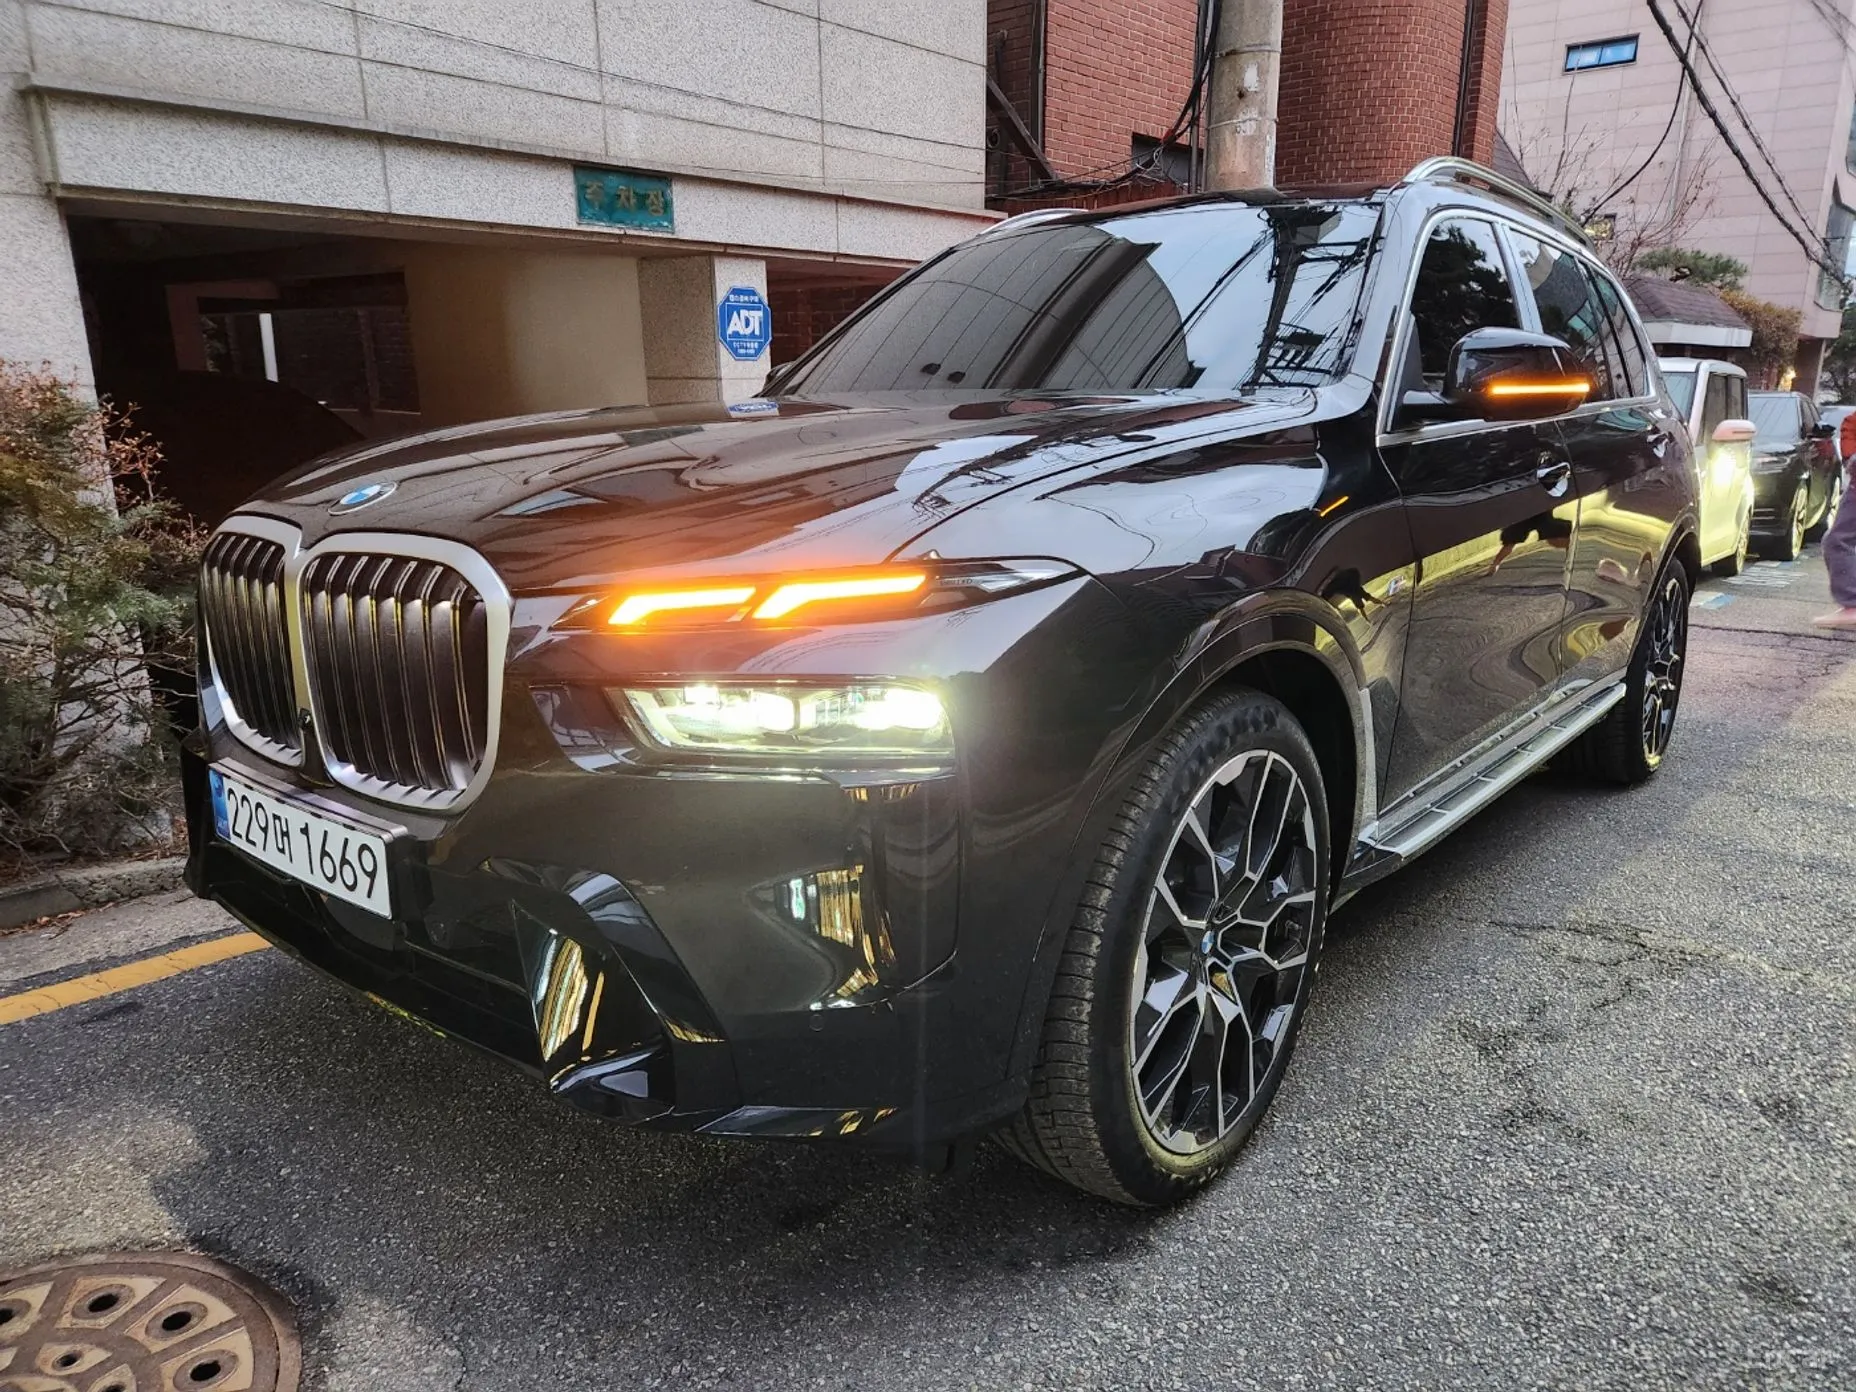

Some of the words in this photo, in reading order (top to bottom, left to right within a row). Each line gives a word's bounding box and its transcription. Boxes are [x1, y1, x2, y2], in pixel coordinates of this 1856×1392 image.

[727, 309, 763, 336] ADT
[227, 787, 293, 864] 229머
[300, 822, 378, 898] 1669
